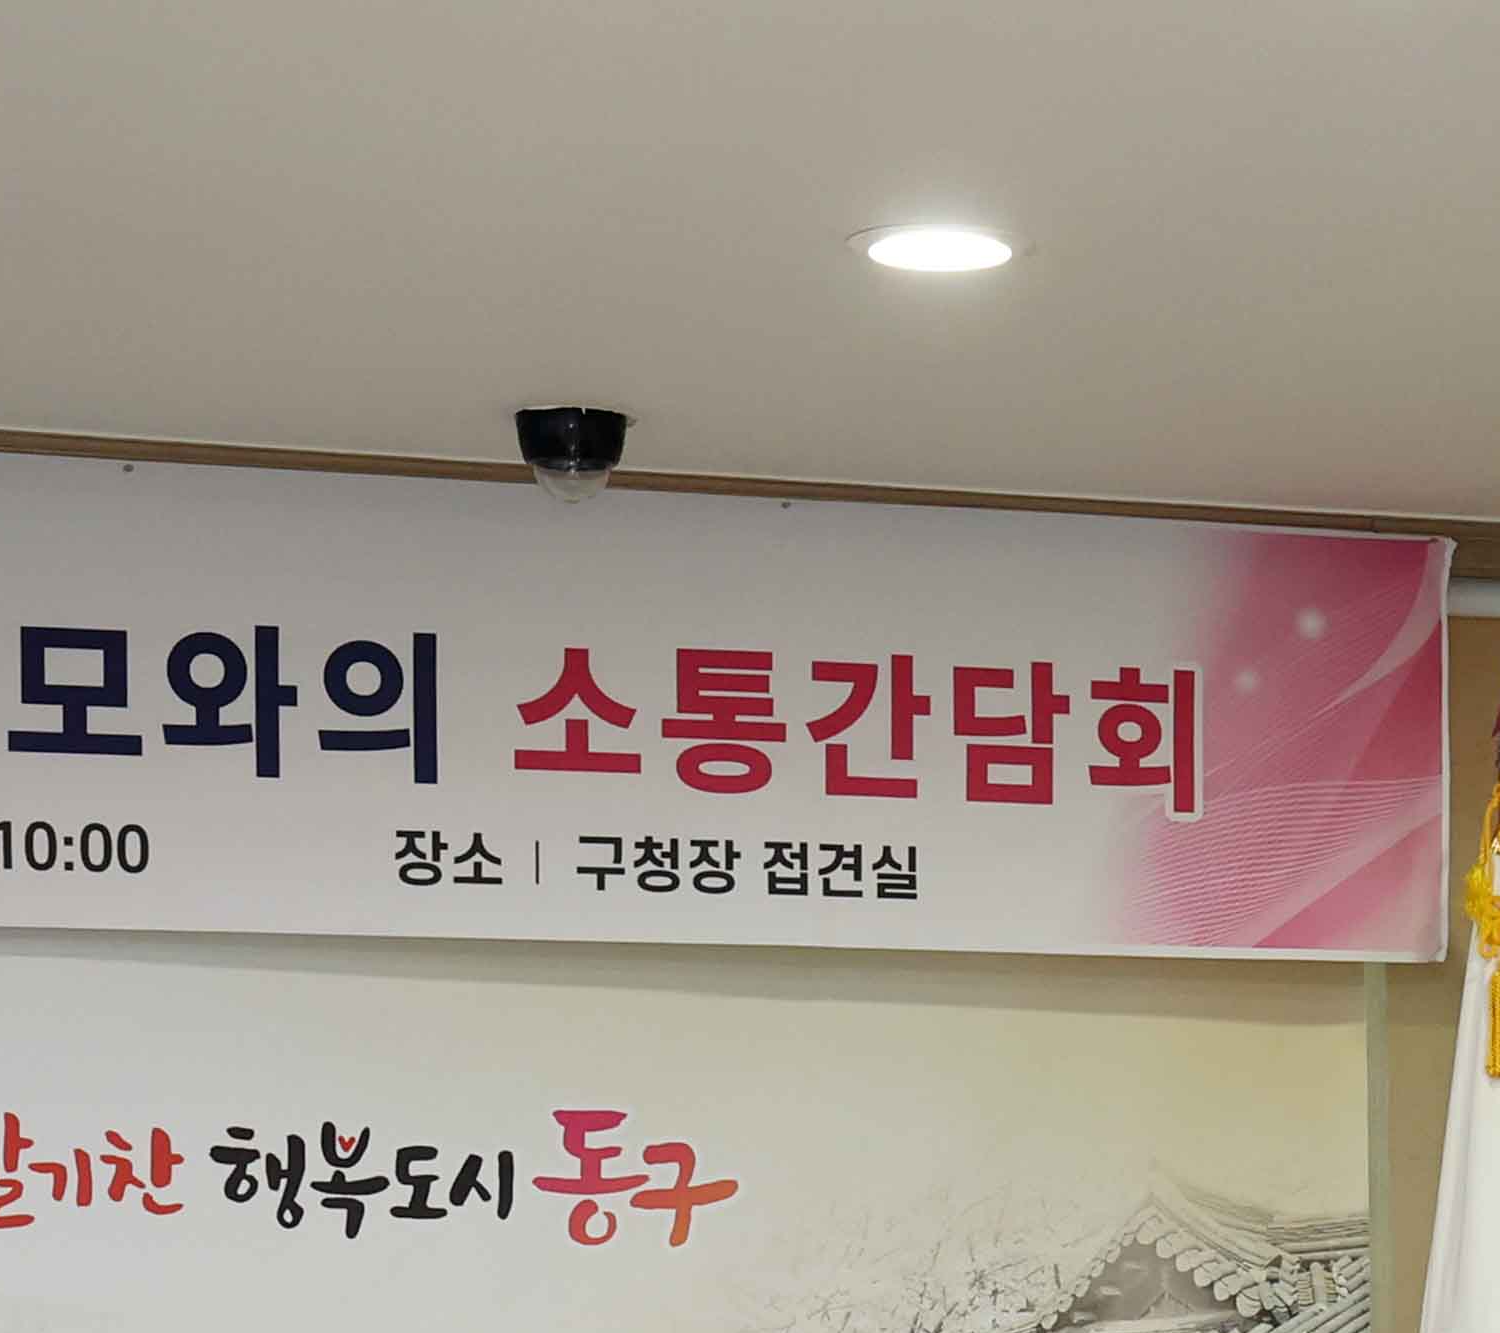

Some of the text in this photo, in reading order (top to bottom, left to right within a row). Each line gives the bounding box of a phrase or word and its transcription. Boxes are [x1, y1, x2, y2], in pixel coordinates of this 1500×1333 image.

[512, 645, 1202, 814] 소통간담회
[394, 828, 919, 901] 장소 구청장 접견실
[209, 1122, 513, 1240] 행복도시
[532, 1109, 739, 1248] 동구
